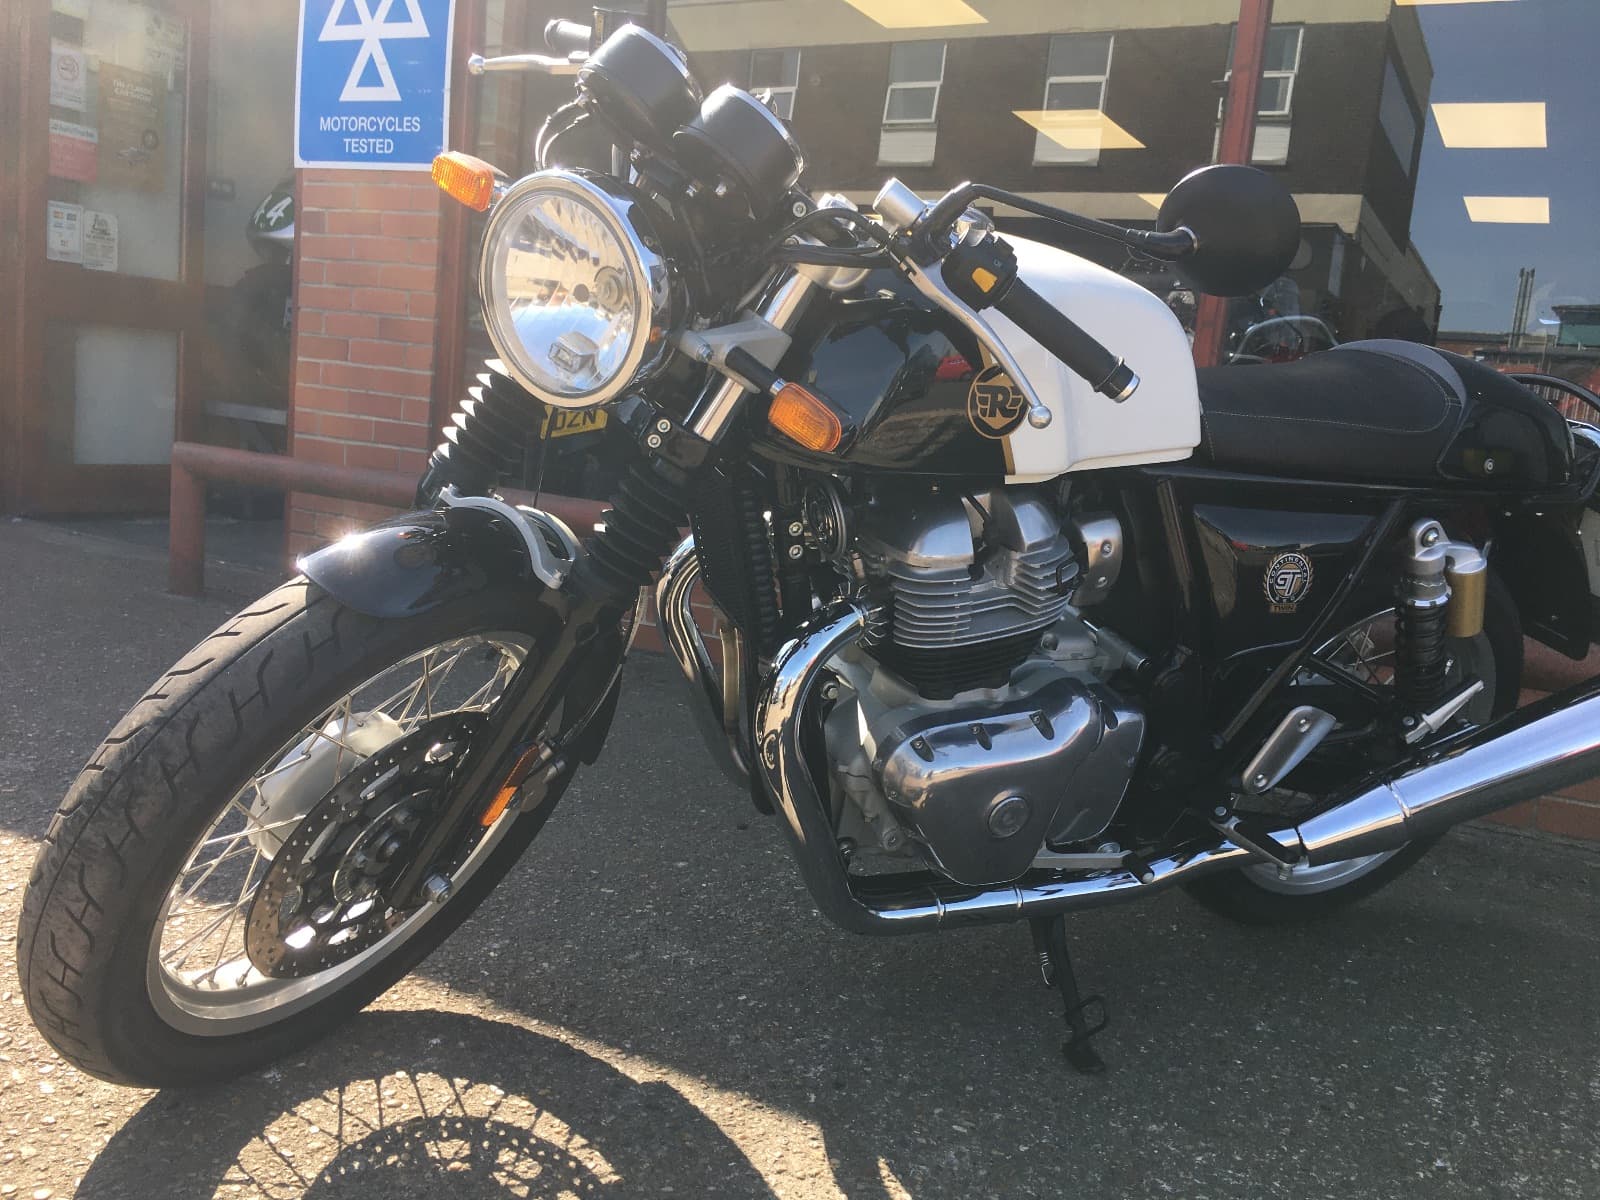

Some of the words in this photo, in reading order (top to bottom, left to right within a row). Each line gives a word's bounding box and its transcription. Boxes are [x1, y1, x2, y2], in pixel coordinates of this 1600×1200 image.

[320, 116, 421, 132] MOTORCYCLES
[343, 138, 394, 153] TESTED
[1275, 569, 1302, 596] GT
